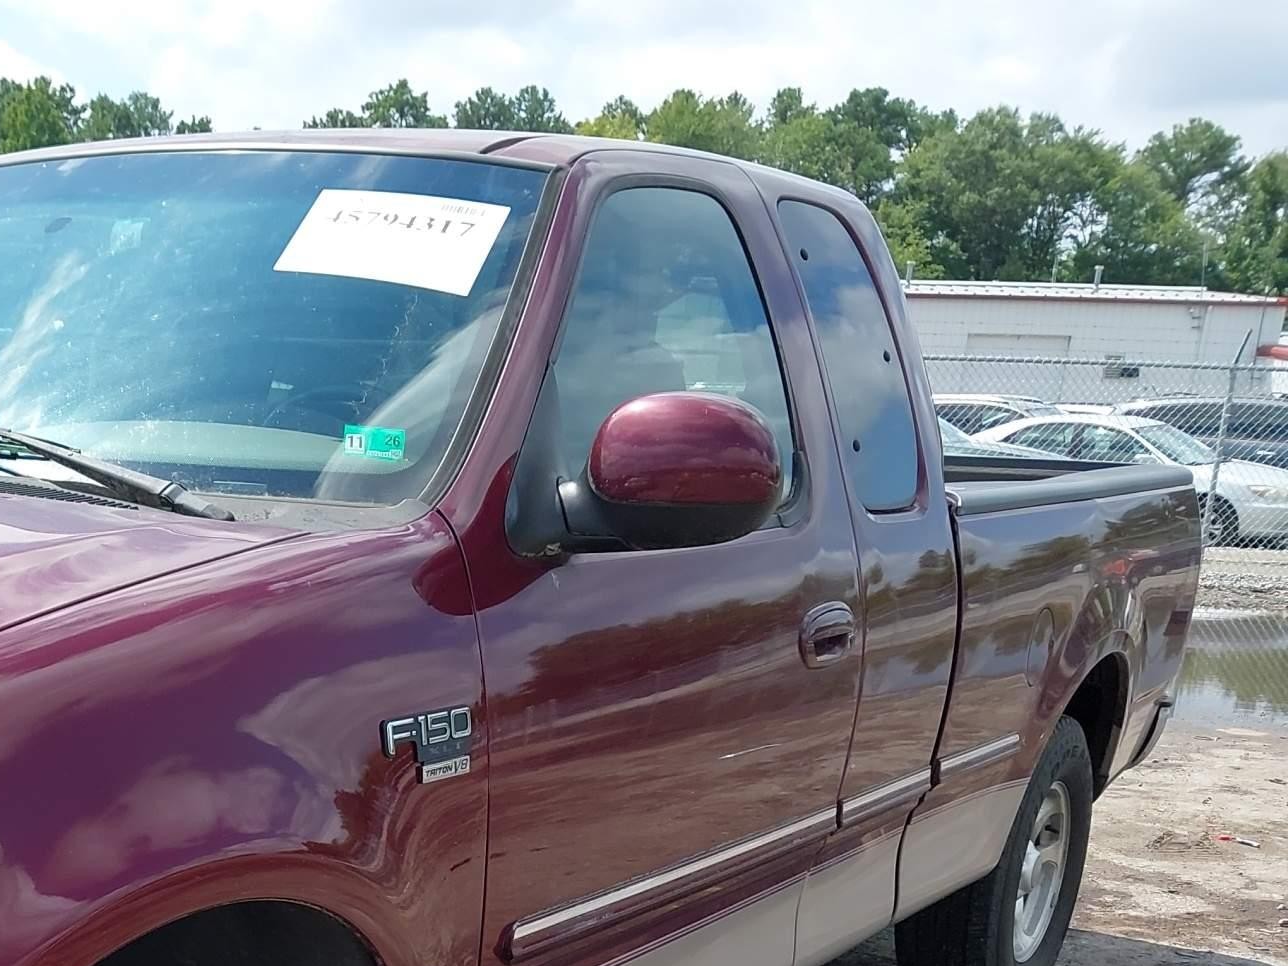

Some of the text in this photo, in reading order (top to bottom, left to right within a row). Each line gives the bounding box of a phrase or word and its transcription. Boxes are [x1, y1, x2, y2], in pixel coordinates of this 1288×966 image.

[327, 208, 476, 237] 45794317
[348, 434, 401, 449] 11 26
[425, 757, 468, 778] TRITON V8
